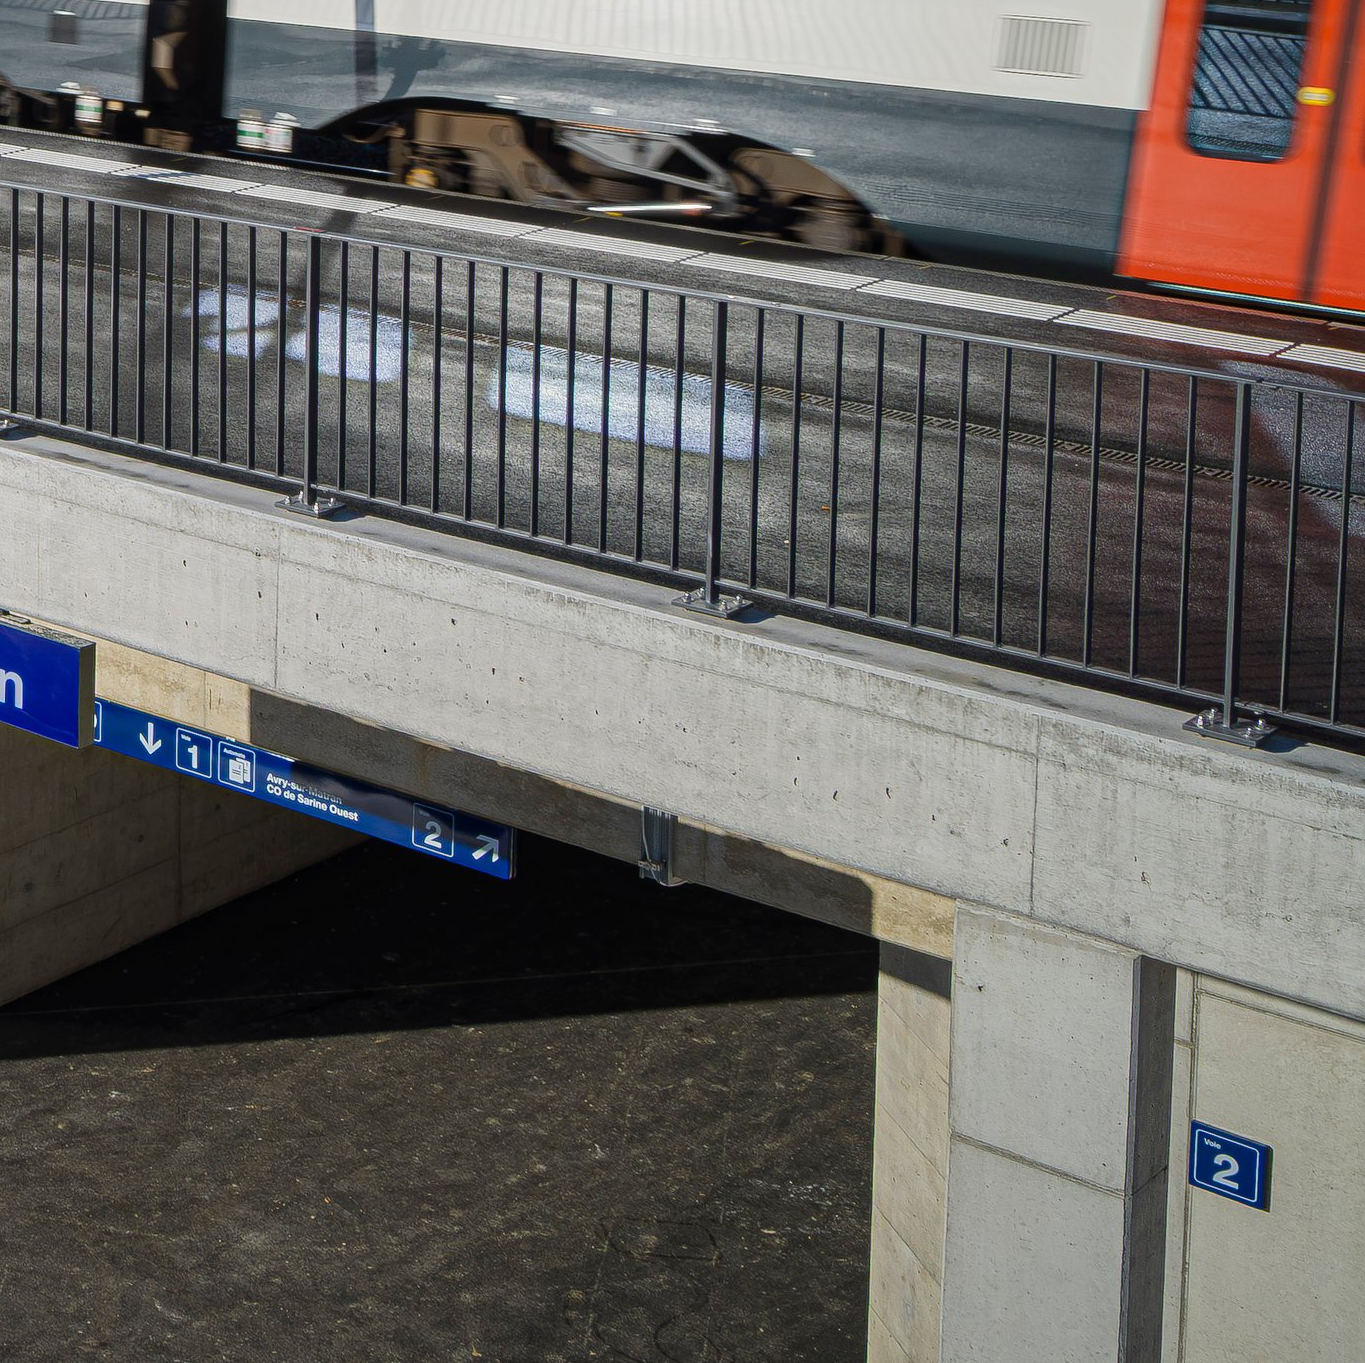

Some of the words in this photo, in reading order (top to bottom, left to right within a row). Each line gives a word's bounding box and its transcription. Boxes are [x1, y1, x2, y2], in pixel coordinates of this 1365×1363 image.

[187, 745, 198, 769] 1
[266, 784, 282, 796] CO
[283, 789, 296, 801] de
[297, 793, 327, 811] Sarine
[329, 804, 359, 821] Ouest
[424, 821, 442, 849] 2
[1203, 1137, 1221, 1150] Voie
[1212, 1153, 1240, 1190] 2
